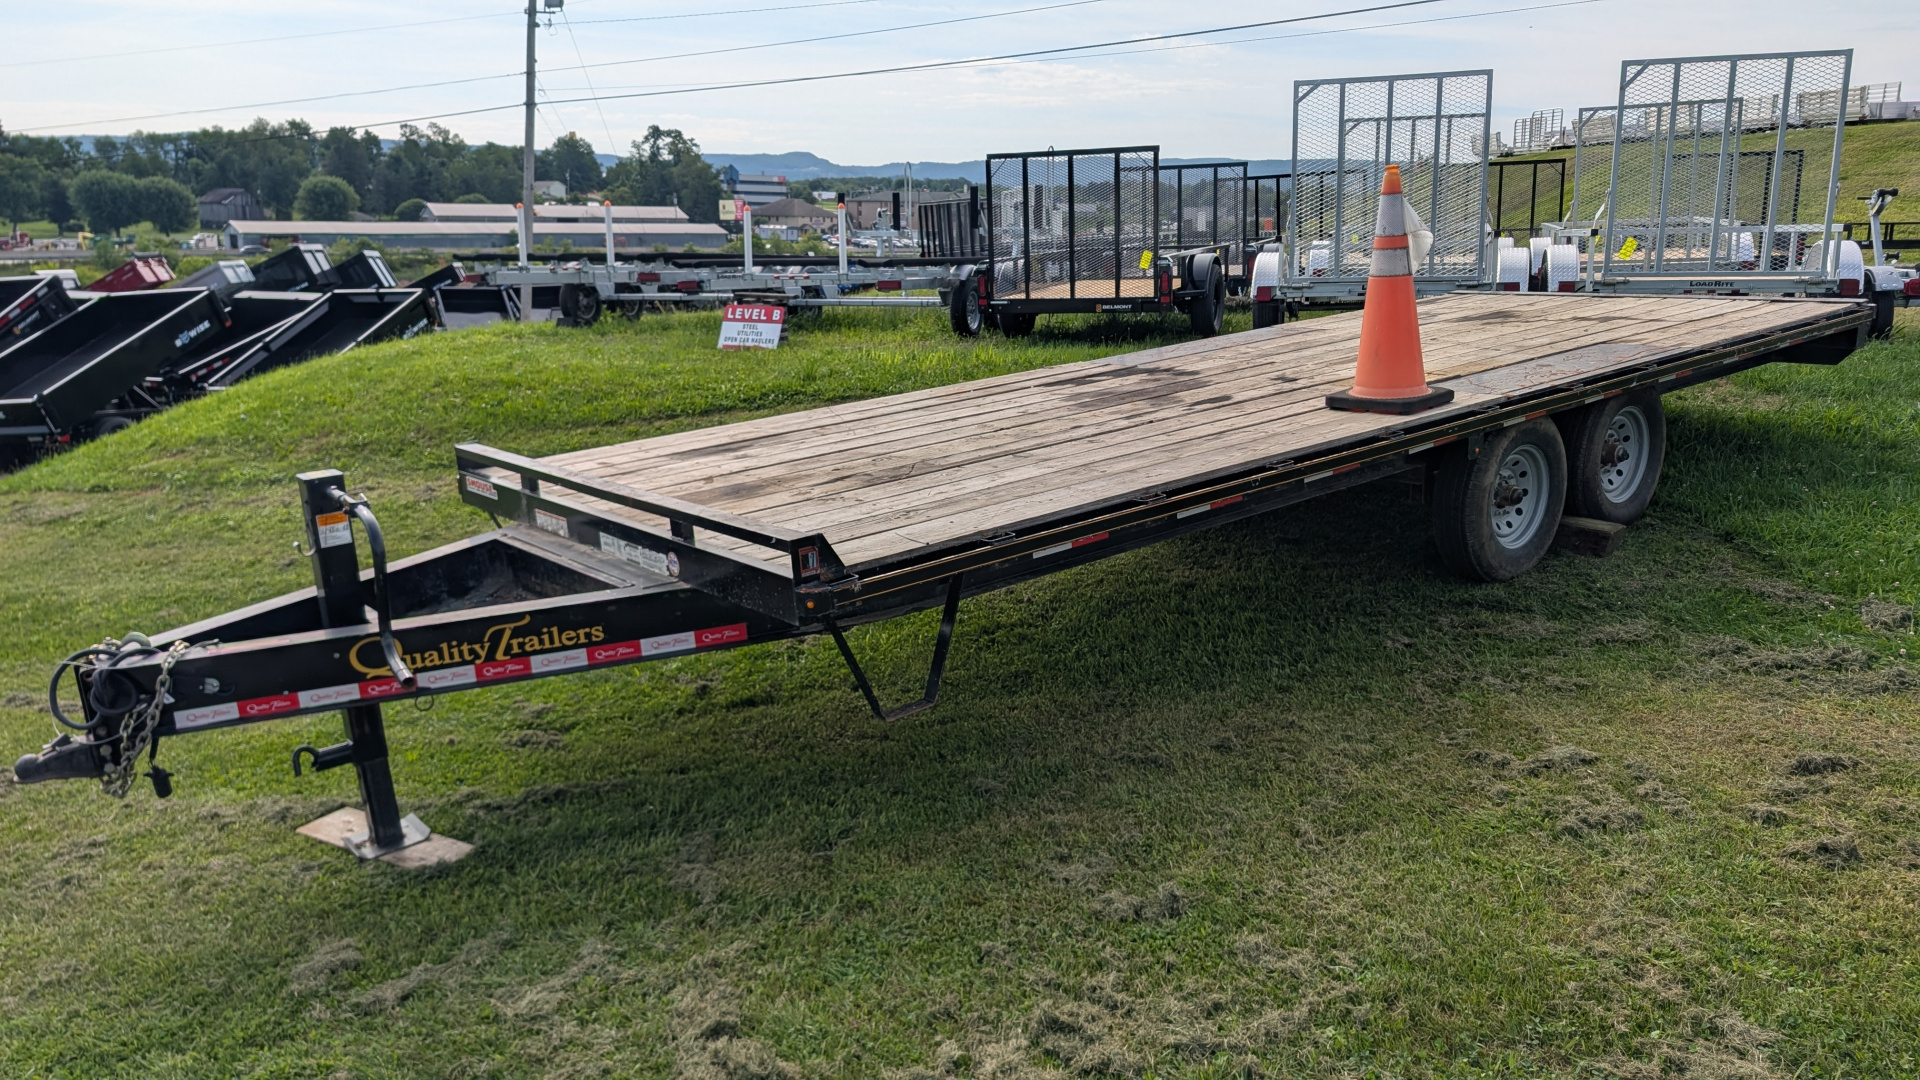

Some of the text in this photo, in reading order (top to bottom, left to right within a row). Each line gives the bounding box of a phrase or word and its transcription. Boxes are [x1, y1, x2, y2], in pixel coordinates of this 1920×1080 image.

[727, 308, 781, 321] LEVEL B
[349, 614, 605, 679] Quality Trailers
